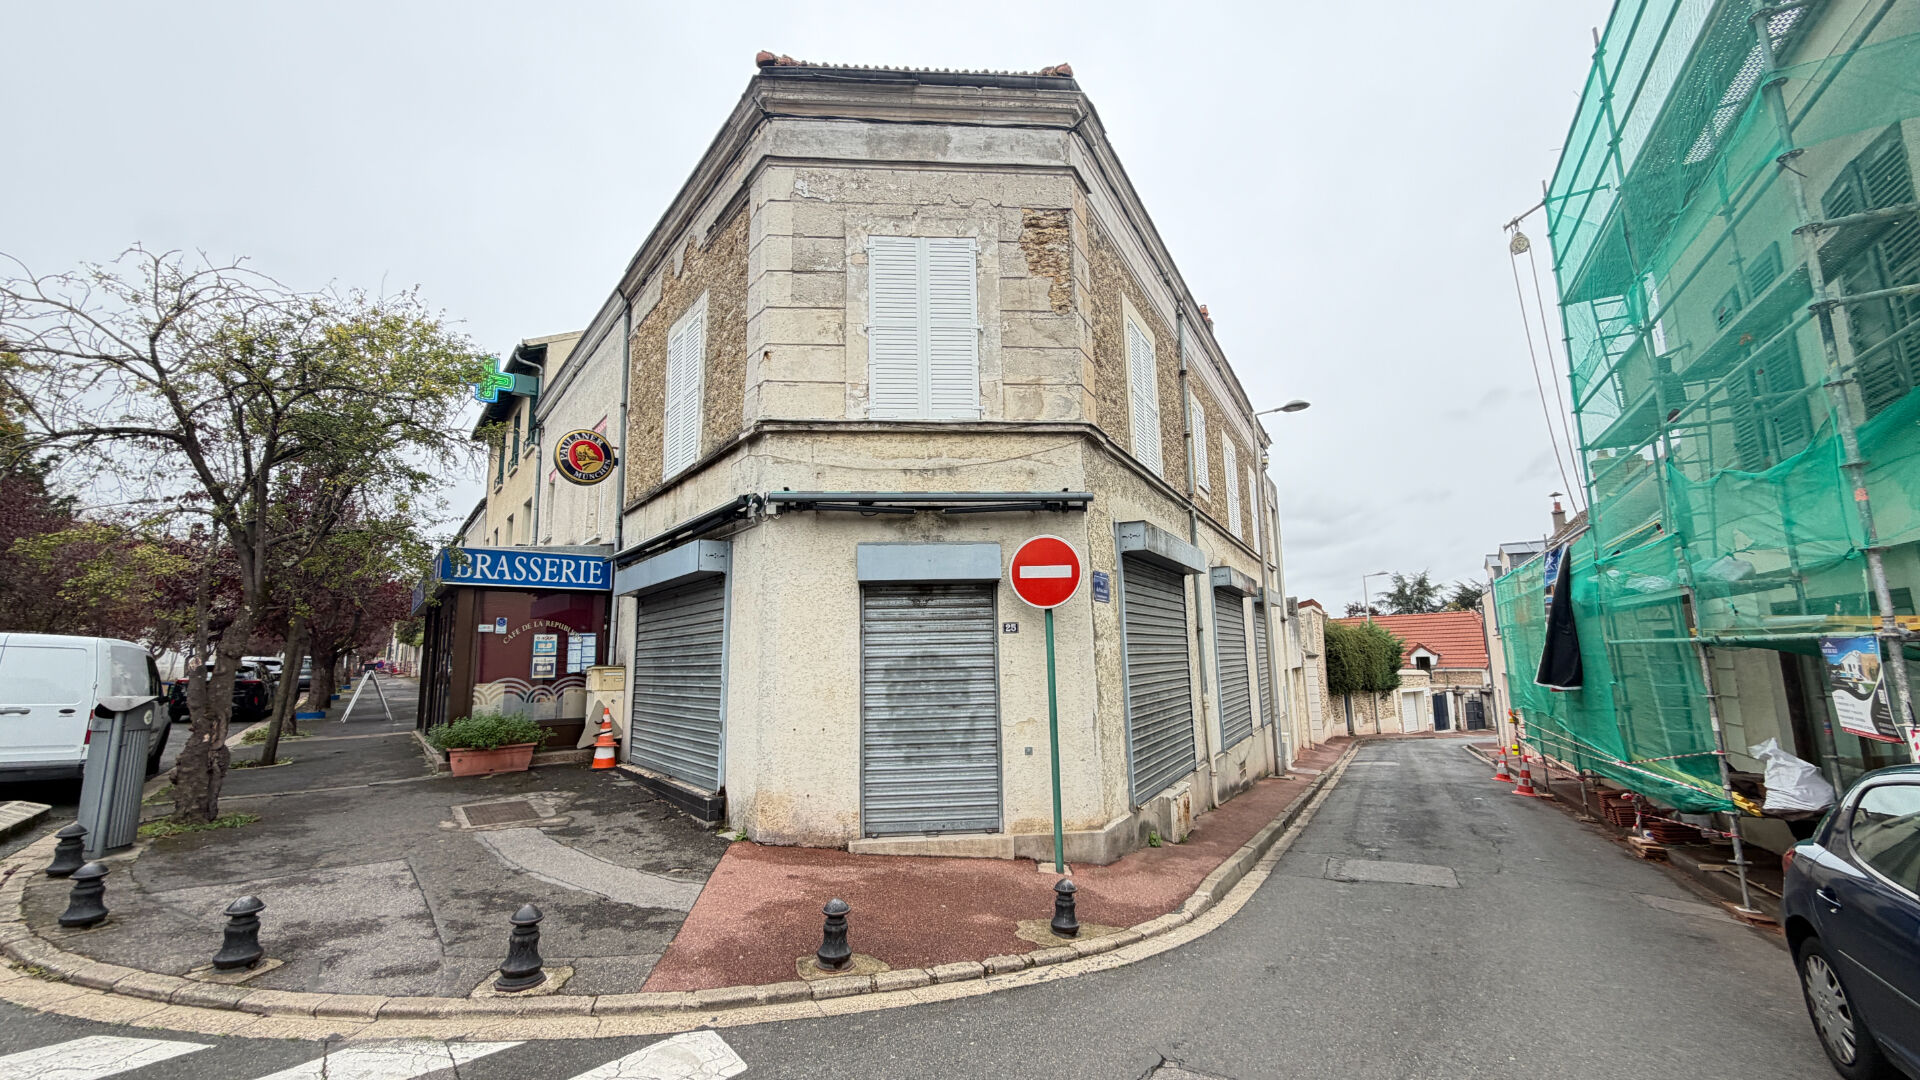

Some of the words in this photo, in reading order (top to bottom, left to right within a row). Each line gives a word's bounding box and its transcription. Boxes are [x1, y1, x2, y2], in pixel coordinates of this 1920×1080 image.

[560, 433, 603, 460] PAULANER
[454, 553, 603, 584] BRASSERIE
[522, 623, 533, 632] DE
[534, 620, 543, 628] LA
[1005, 623, 1016, 632] 25
